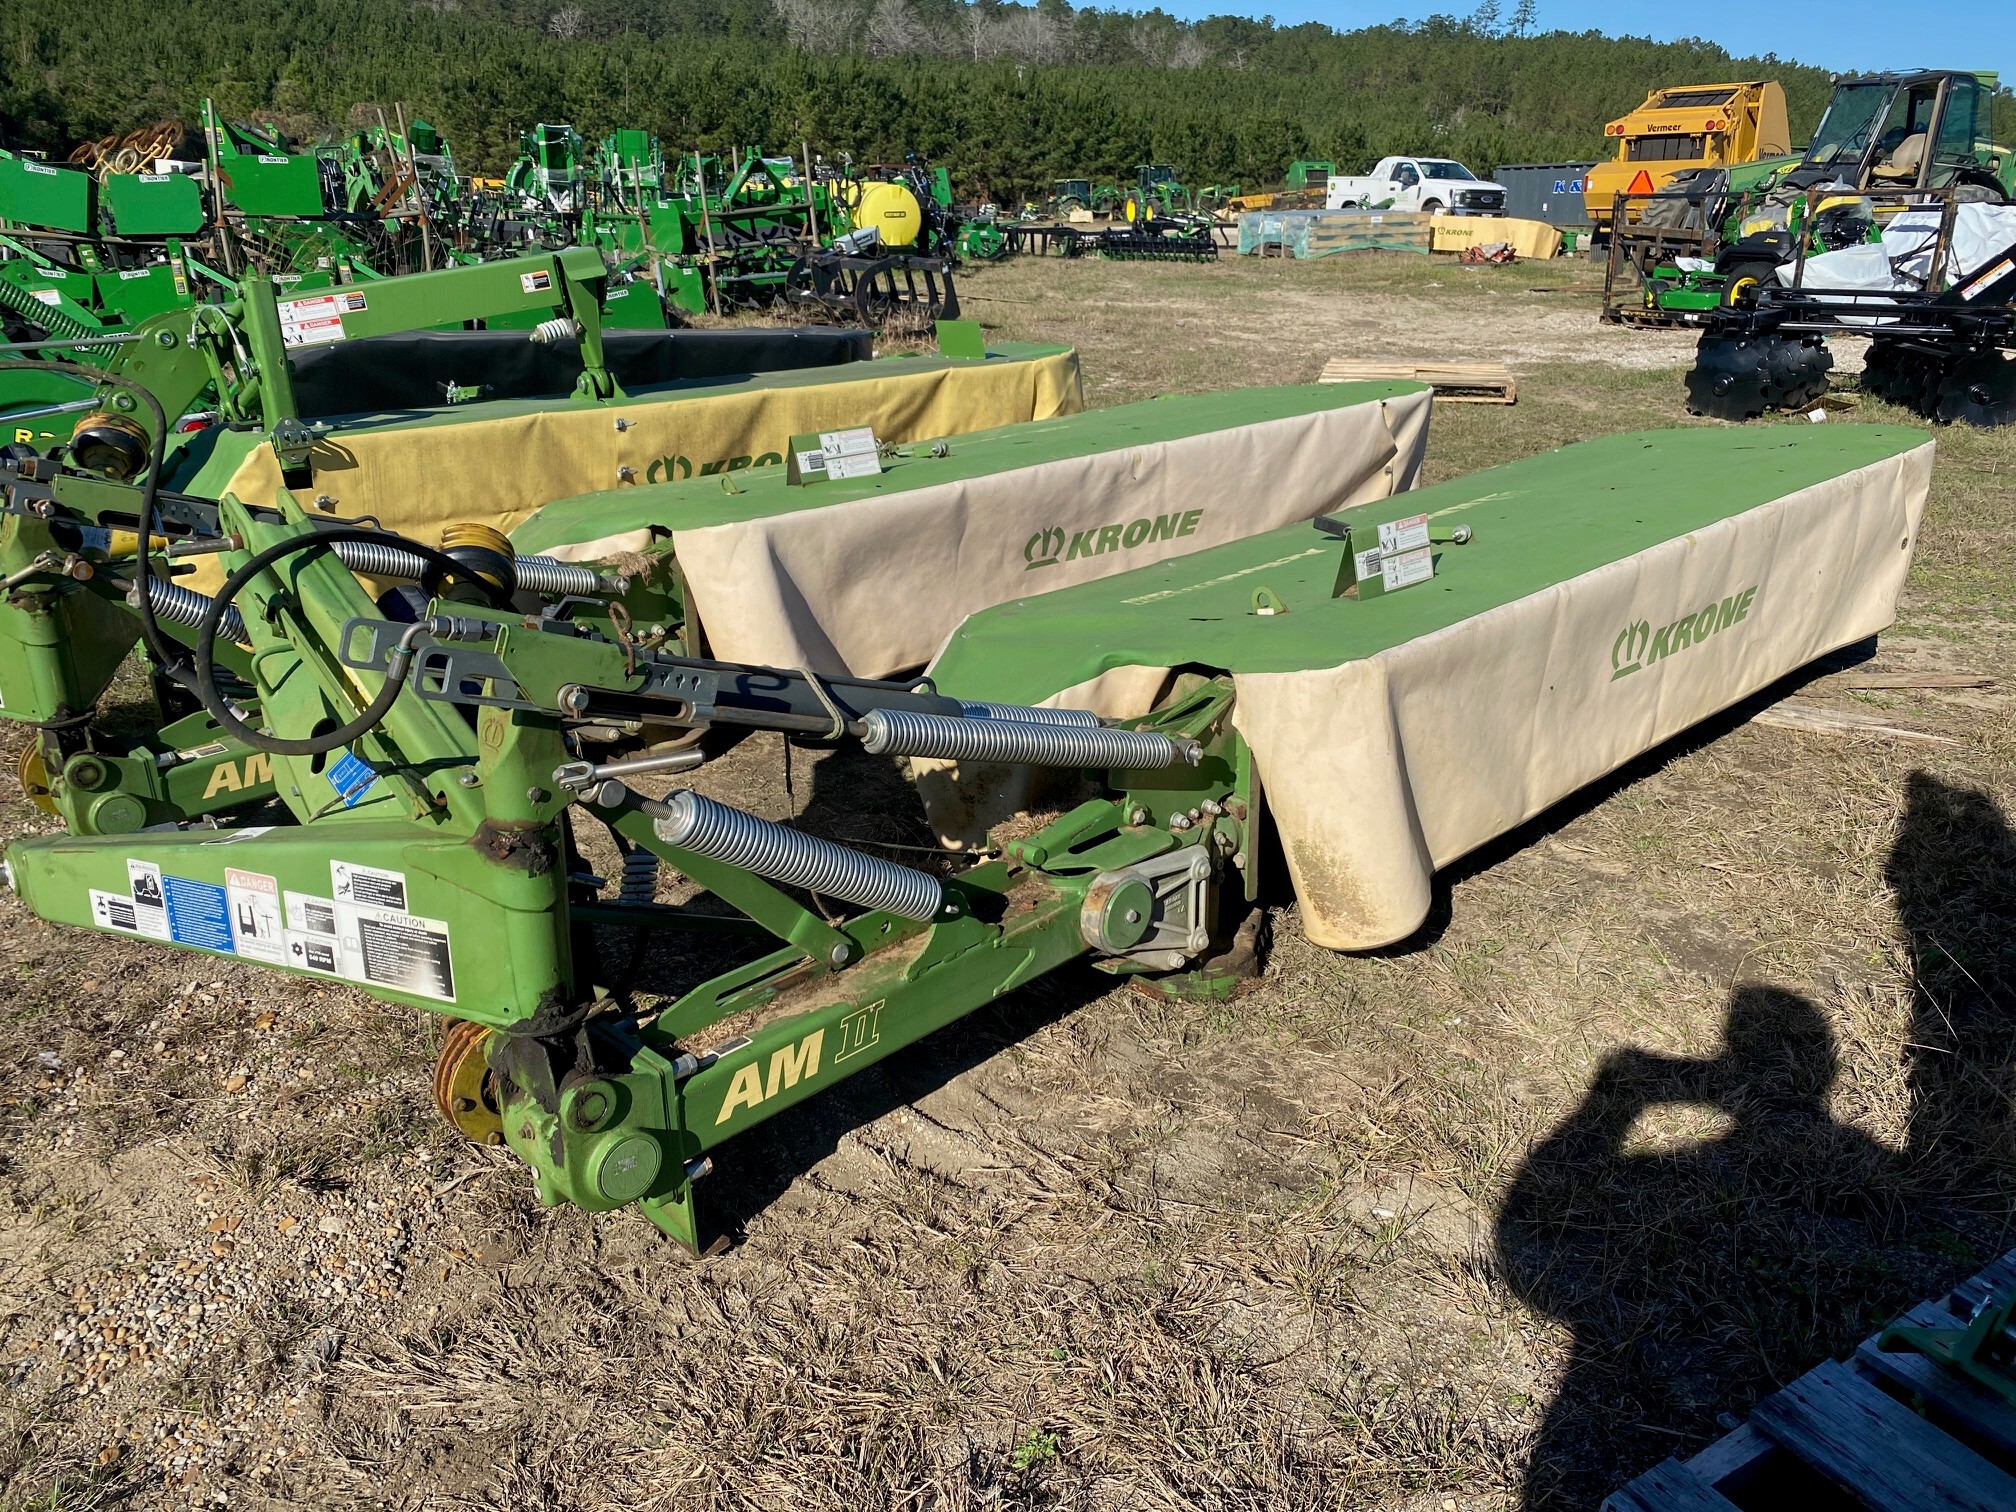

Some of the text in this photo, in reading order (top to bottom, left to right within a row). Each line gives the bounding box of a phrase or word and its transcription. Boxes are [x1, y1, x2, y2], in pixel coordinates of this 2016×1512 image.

[1647, 124, 1682, 132] Vermeer
[1553, 180, 1565, 194] K
[1445, 229, 1474, 237] KRONE
[310, 320, 332, 328] DANGER
[1065, 508, 1204, 561] KRONE
[1647, 585, 1758, 666] KRONE
[240, 876, 275, 893] DANGER
[383, 913, 426, 929] CAUTION
[715, 1028, 825, 1126] AM
